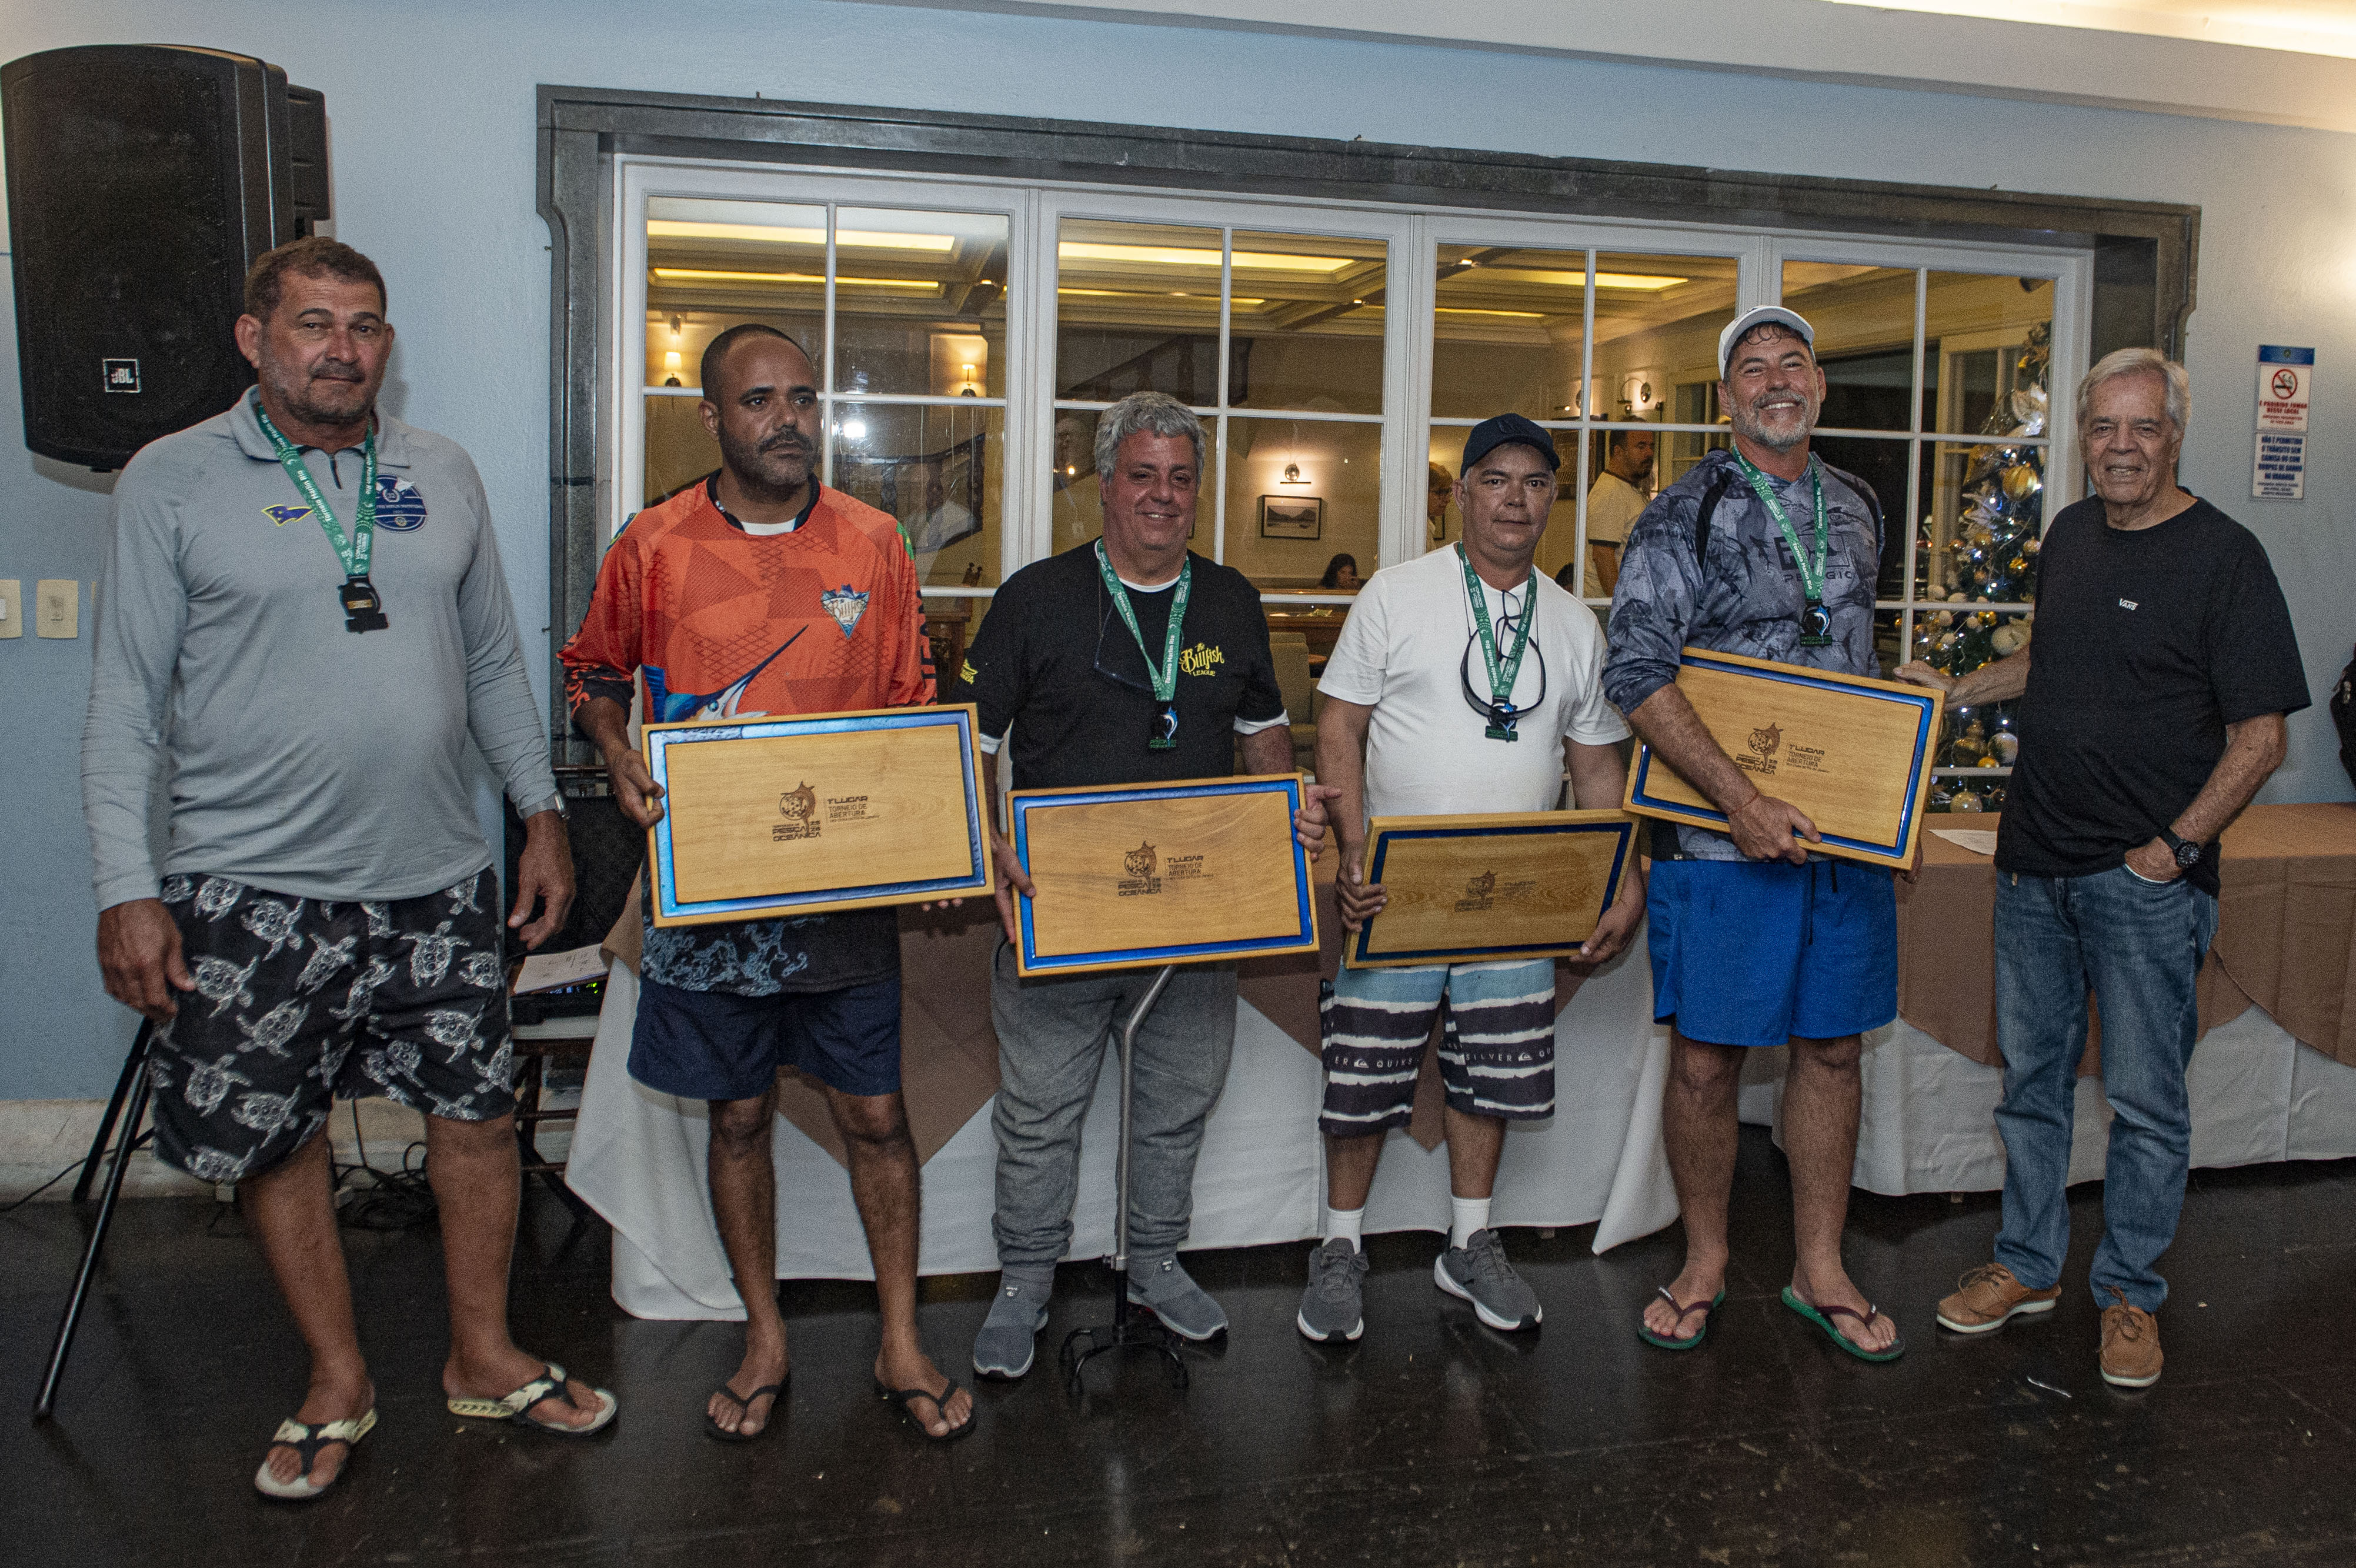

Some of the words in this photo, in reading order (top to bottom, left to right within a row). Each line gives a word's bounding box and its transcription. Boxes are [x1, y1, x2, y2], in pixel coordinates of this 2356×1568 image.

[111, 368, 135, 383] JBL
[296, 469, 307, 482] Rio
[303, 480, 319, 501] Marlin
[314, 499, 332, 522] Torneio
[1792, 543, 1804, 562] Torneio
[1784, 571, 1853, 583] PEGIC
[1116, 592, 1127, 612] Torneio
[2118, 598, 2139, 610] VANS
[1179, 646, 1225, 675] Billfish
[829, 805, 857, 813] TORNEIO
[829, 810, 866, 819] ABERTURA
[1169, 869, 1201, 877] ABERTURA
